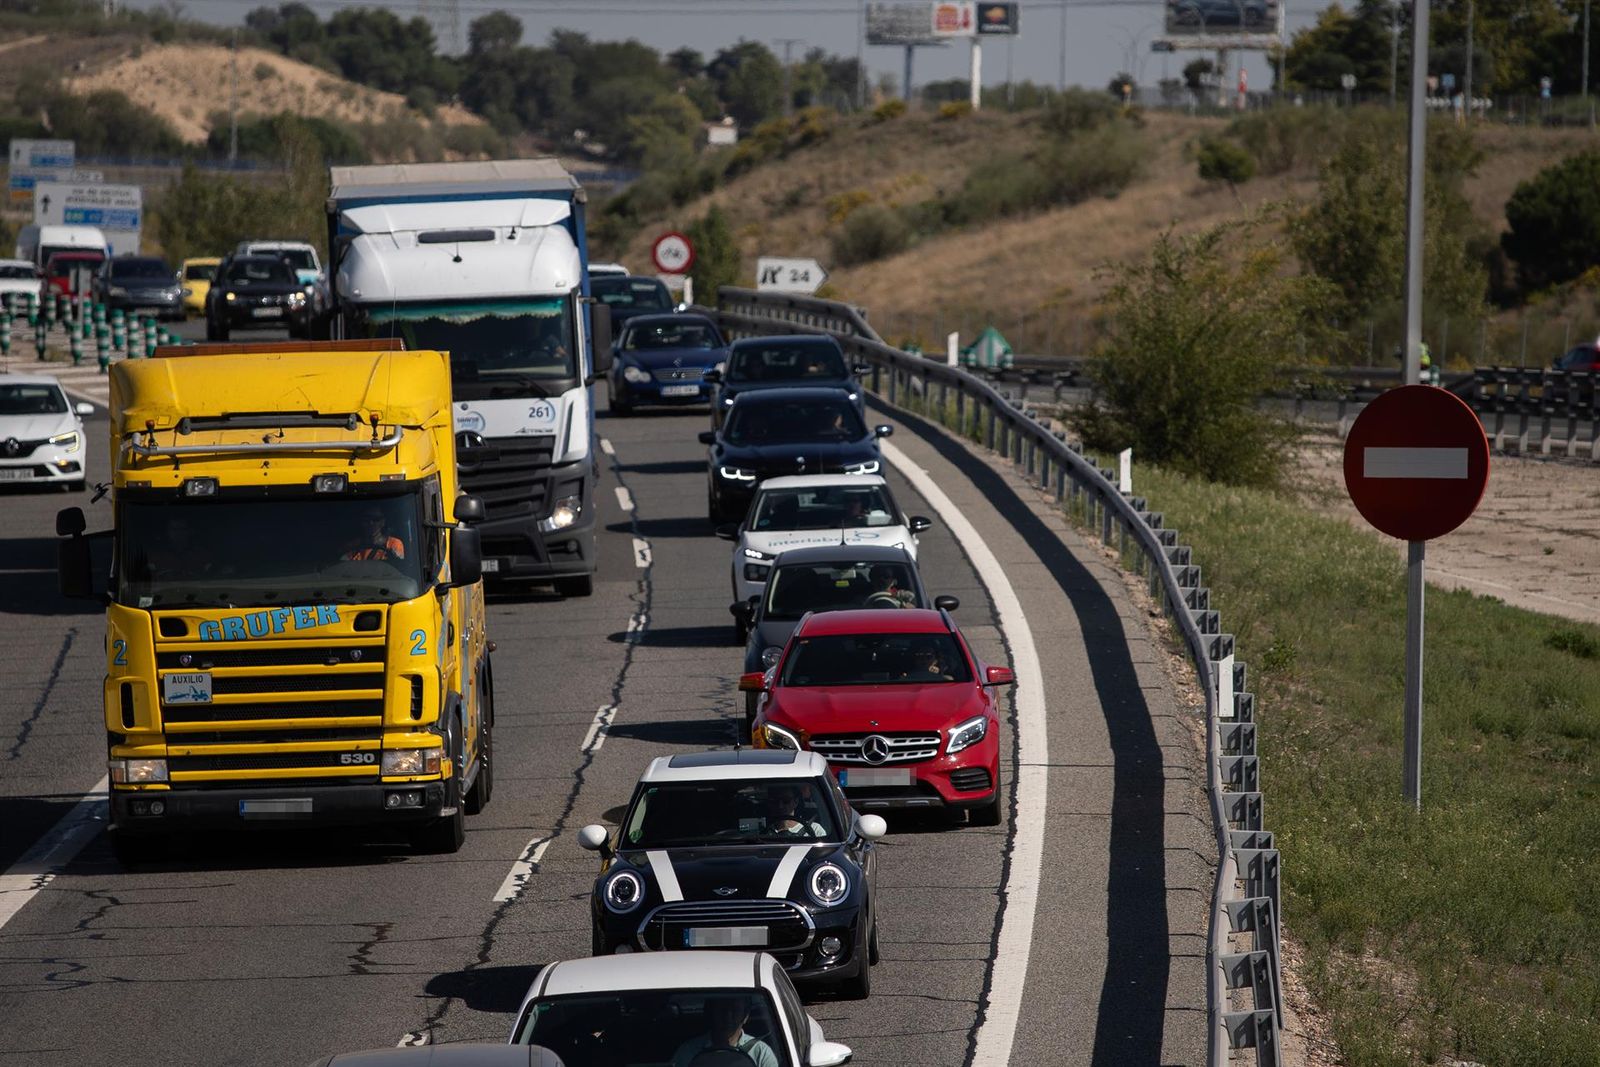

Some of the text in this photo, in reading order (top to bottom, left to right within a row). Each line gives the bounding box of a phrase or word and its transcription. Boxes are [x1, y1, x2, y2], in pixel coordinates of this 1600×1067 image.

[790, 268, 810, 282] 24
[528, 406, 550, 419] 261
[199, 604, 341, 641] GRUFER
[410, 629, 427, 655] 2
[113, 640, 128, 665] 2
[172, 675, 204, 685] AUXILIO
[340, 752, 375, 764] 530
